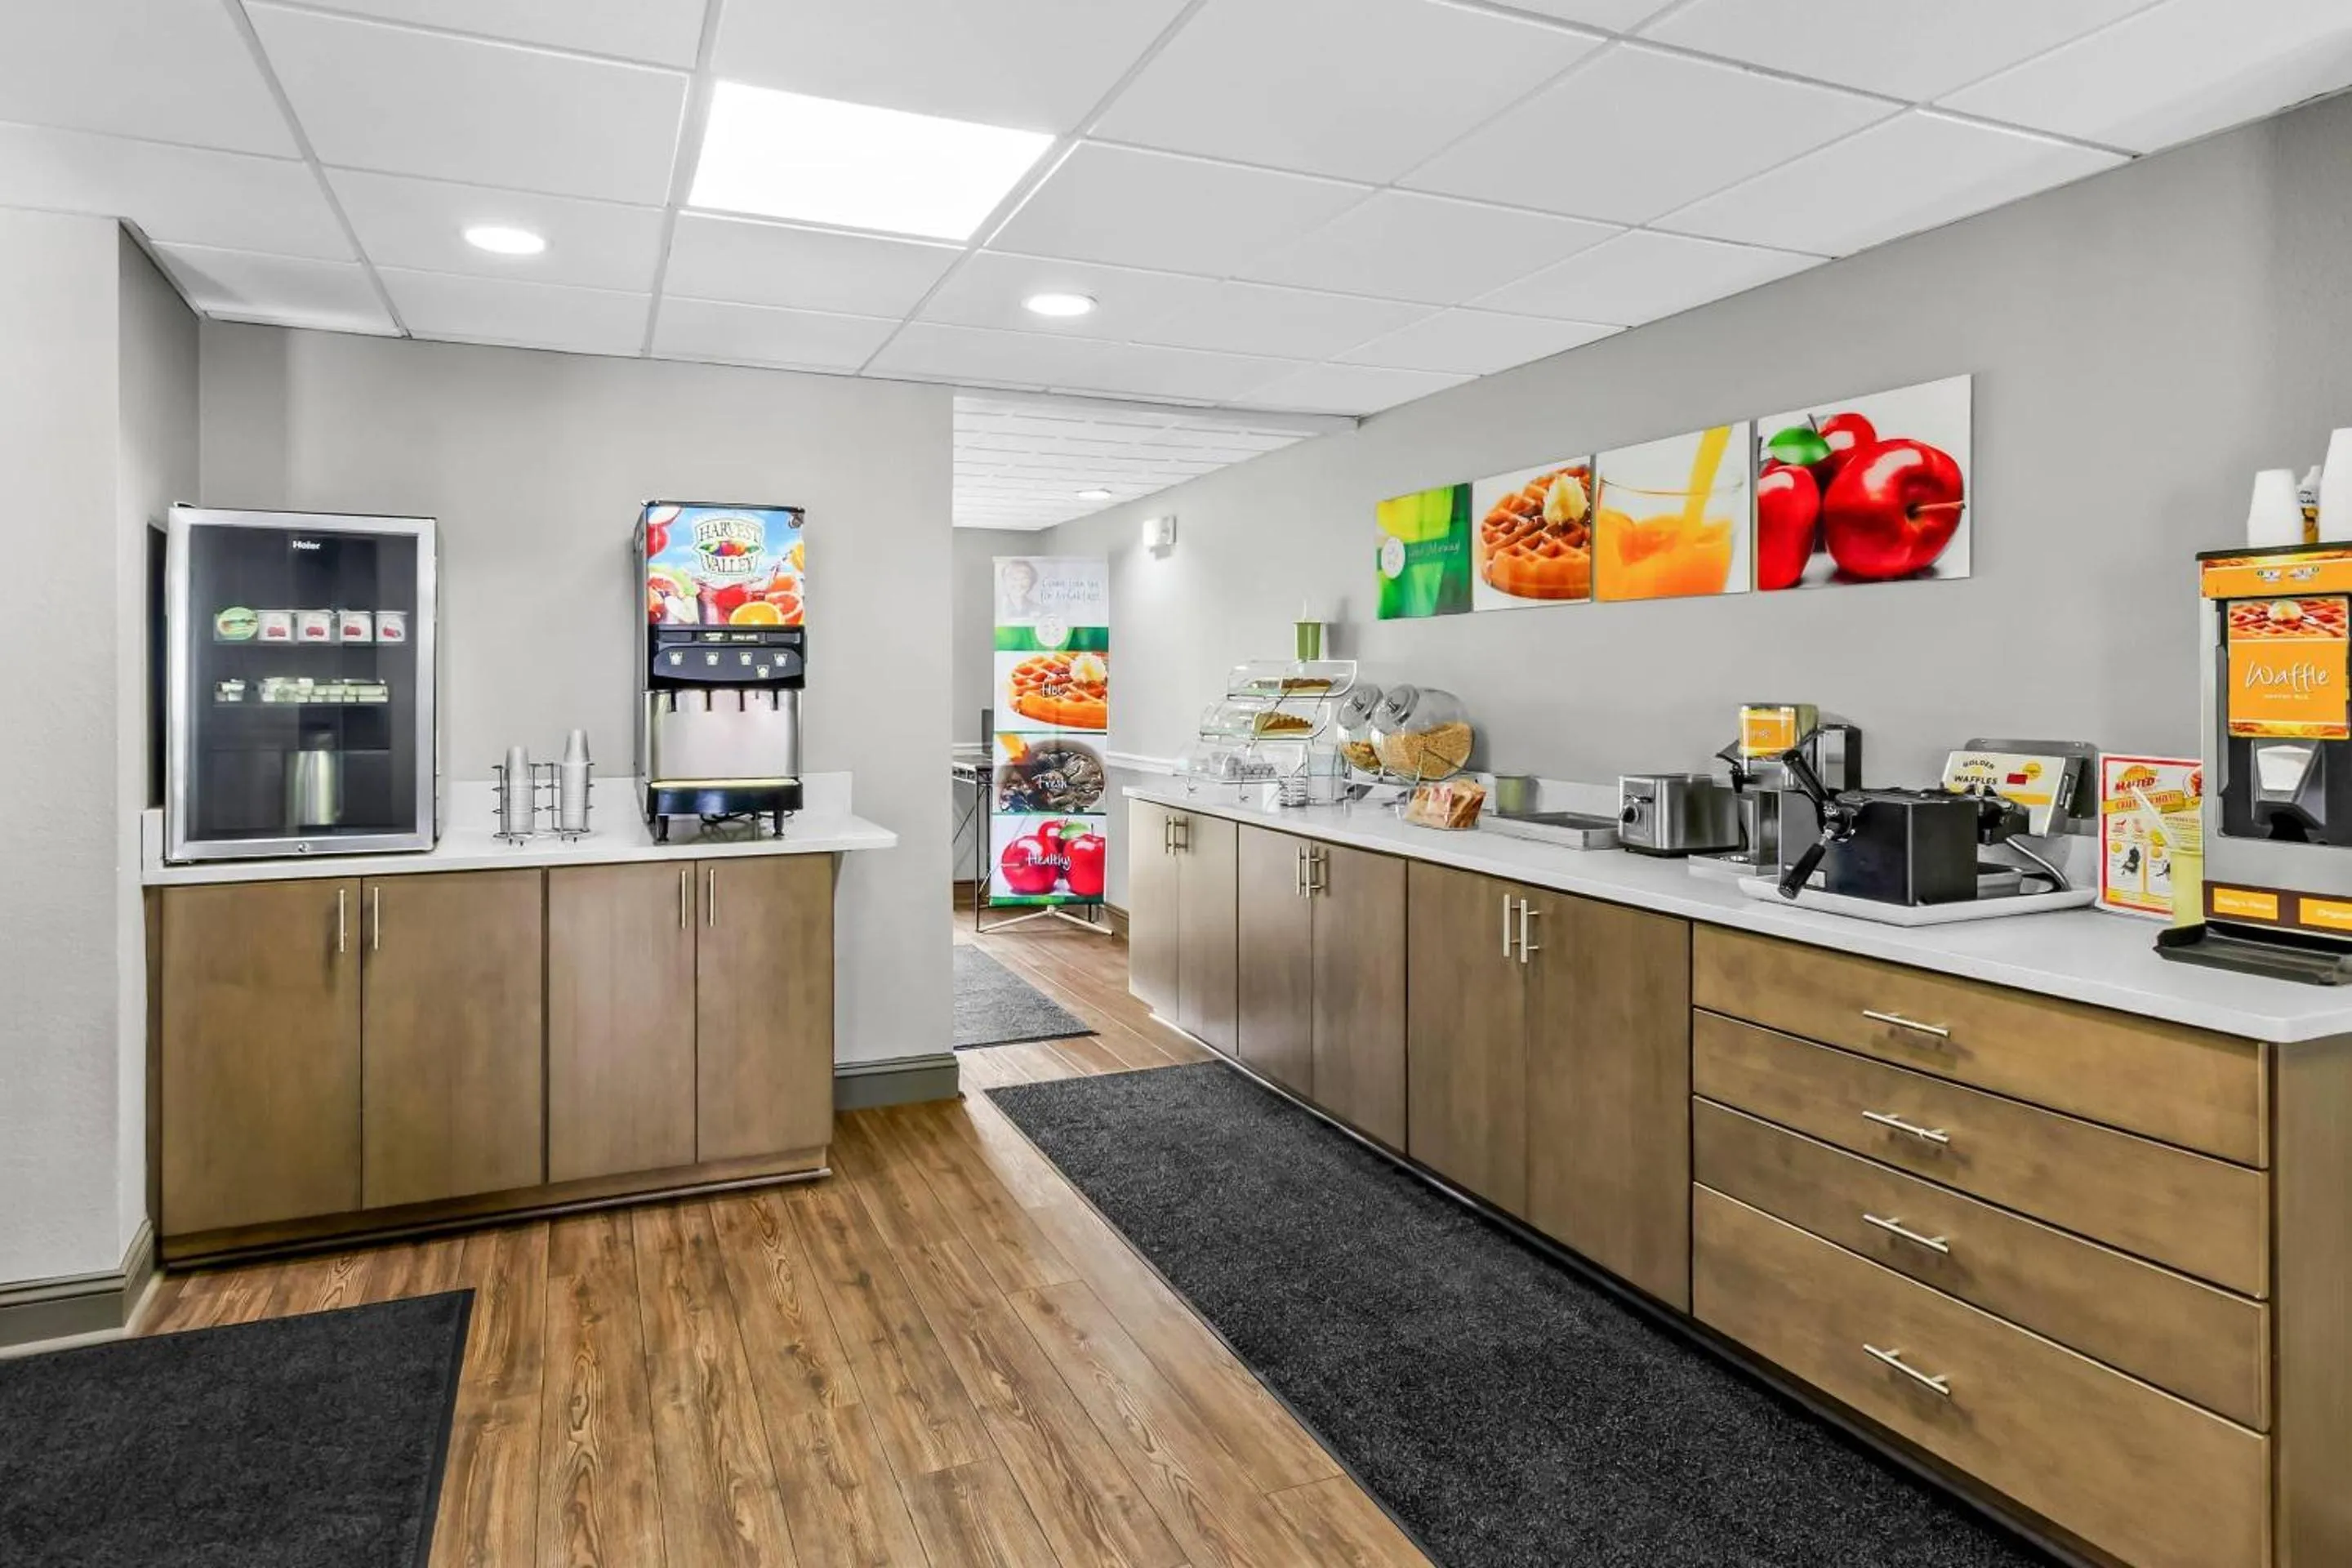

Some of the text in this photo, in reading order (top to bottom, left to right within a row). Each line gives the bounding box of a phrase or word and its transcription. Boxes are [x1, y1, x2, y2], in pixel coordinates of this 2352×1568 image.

[698, 522, 758, 543] HARVEST
[292, 540, 321, 550] Haier
[703, 555, 754, 573] VALLEY
[2245, 661, 2331, 692] Waffle
[1041, 681, 1065, 697] Hot
[1962, 759, 1995, 770] GOLDEN
[1031, 773, 1067, 790] Fresh
[1953, 774, 1998, 785] WAFFLES
[1026, 852, 1071, 871] Healthy
